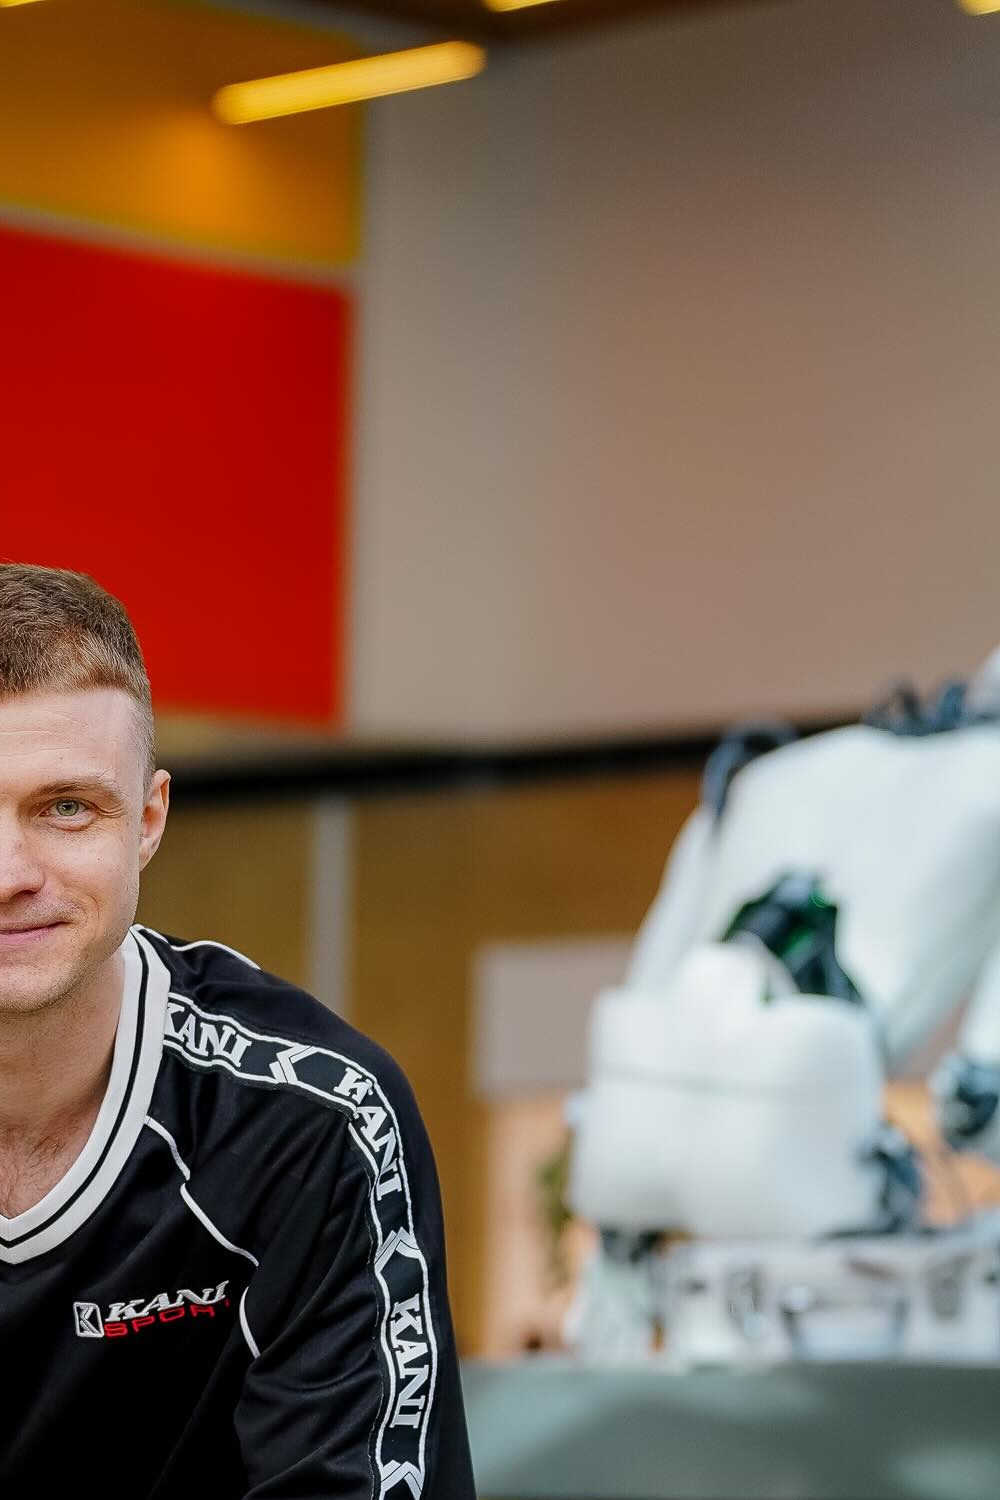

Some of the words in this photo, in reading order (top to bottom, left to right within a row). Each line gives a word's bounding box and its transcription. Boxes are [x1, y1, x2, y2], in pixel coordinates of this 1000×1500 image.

[333, 1066, 403, 1202] KANI
[105, 1279, 230, 1323] KANI
[389, 1293, 432, 1429] KANI
